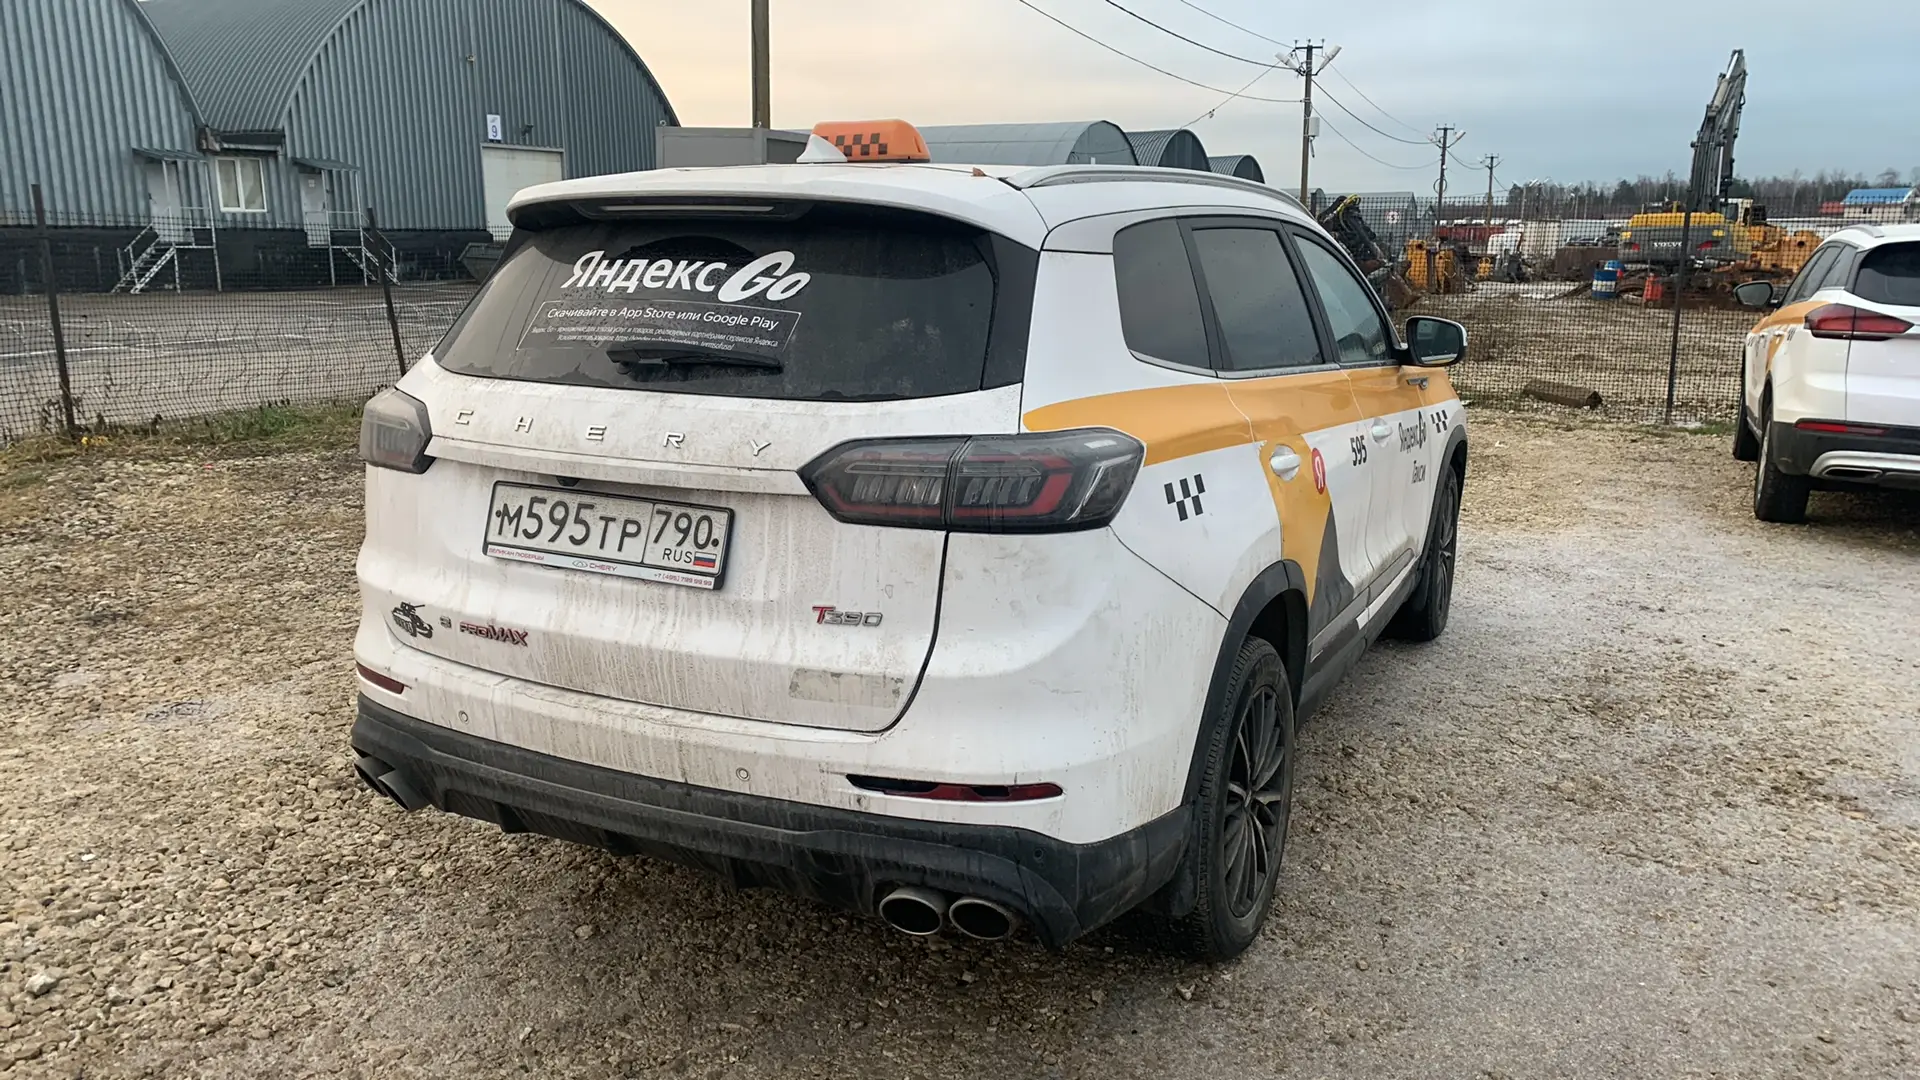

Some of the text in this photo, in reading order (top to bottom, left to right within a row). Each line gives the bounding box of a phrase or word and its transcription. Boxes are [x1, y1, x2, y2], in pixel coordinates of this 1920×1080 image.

[490, 124, 498, 138] 9
[560, 250, 812, 302] Яндекс Go
[547, 306, 780, 331] Скачивайте в App Store или Google Play
[455, 409, 772, 457] CHERY
[1349, 435, 1368, 467] 595
[1314, 455, 1325, 490] Я
[652, 509, 714, 550] 790
[589, 562, 618, 572] CHERY
[662, 548, 693, 564] RUS
[812, 605, 884, 628] T390
